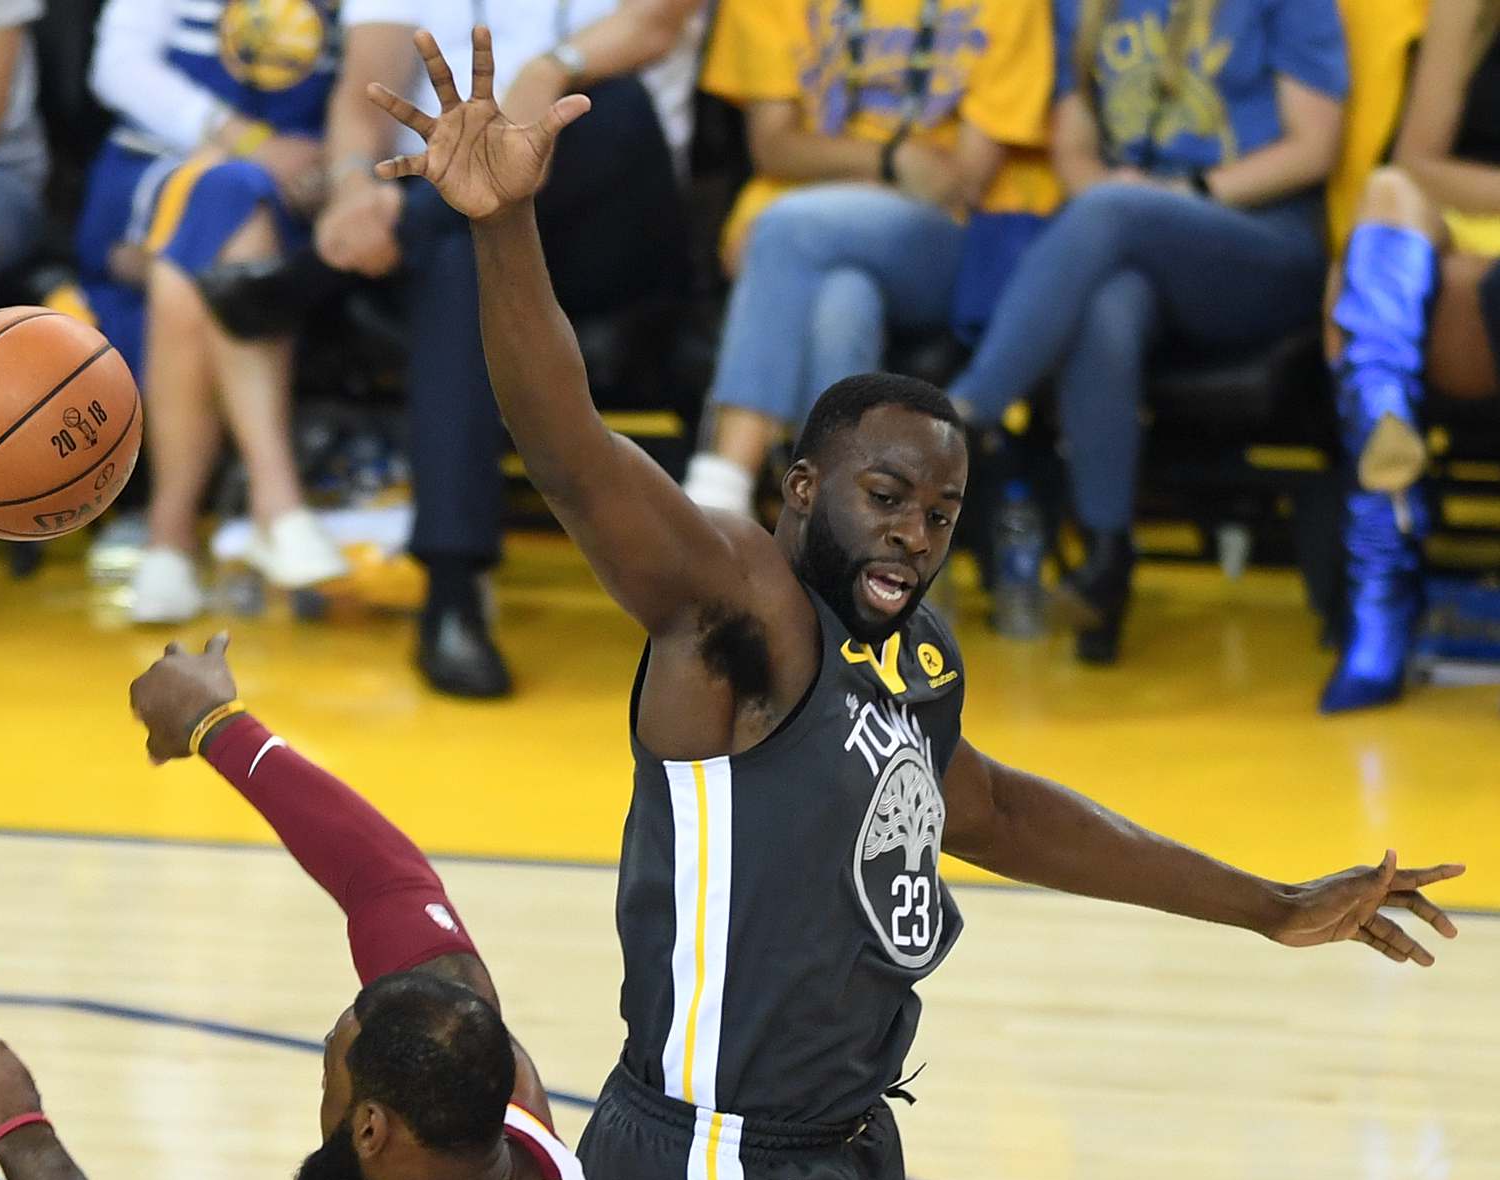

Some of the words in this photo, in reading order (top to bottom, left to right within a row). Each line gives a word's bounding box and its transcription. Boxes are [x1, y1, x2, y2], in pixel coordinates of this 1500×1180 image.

[51, 409, 77, 459] 20
[88, 400, 108, 427] 18
[891, 874, 930, 947] 23
